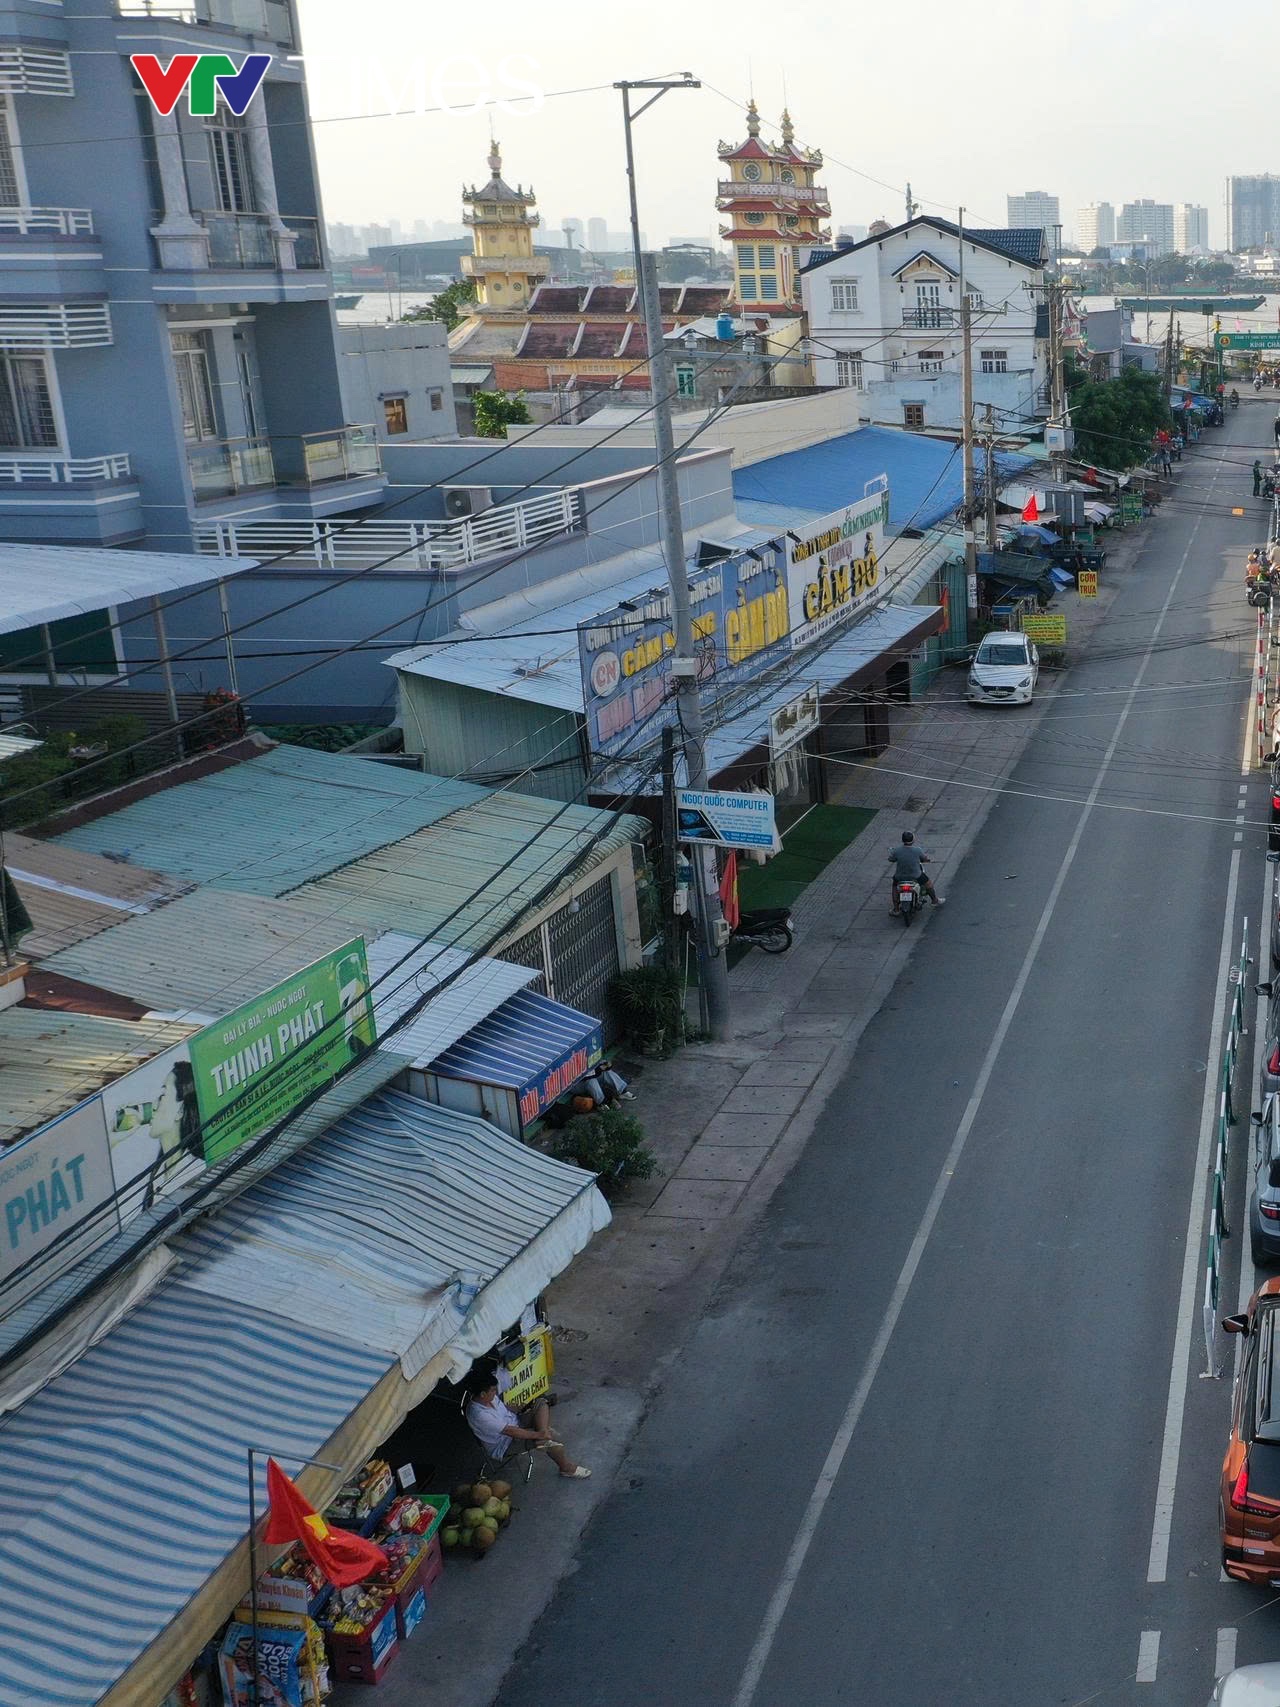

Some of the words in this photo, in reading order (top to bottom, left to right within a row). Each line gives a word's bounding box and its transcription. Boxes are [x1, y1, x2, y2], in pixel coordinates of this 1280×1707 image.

[727, 798, 769, 812] COMPUTER
[210, 1033, 275, 1098] THỊNH
[278, 1000, 326, 1056] PHÁT
[5, 1153, 86, 1250] PHÁT
[530, 1374, 547, 1396] CHẤT
[267, 1645, 286, 1680] COOL
